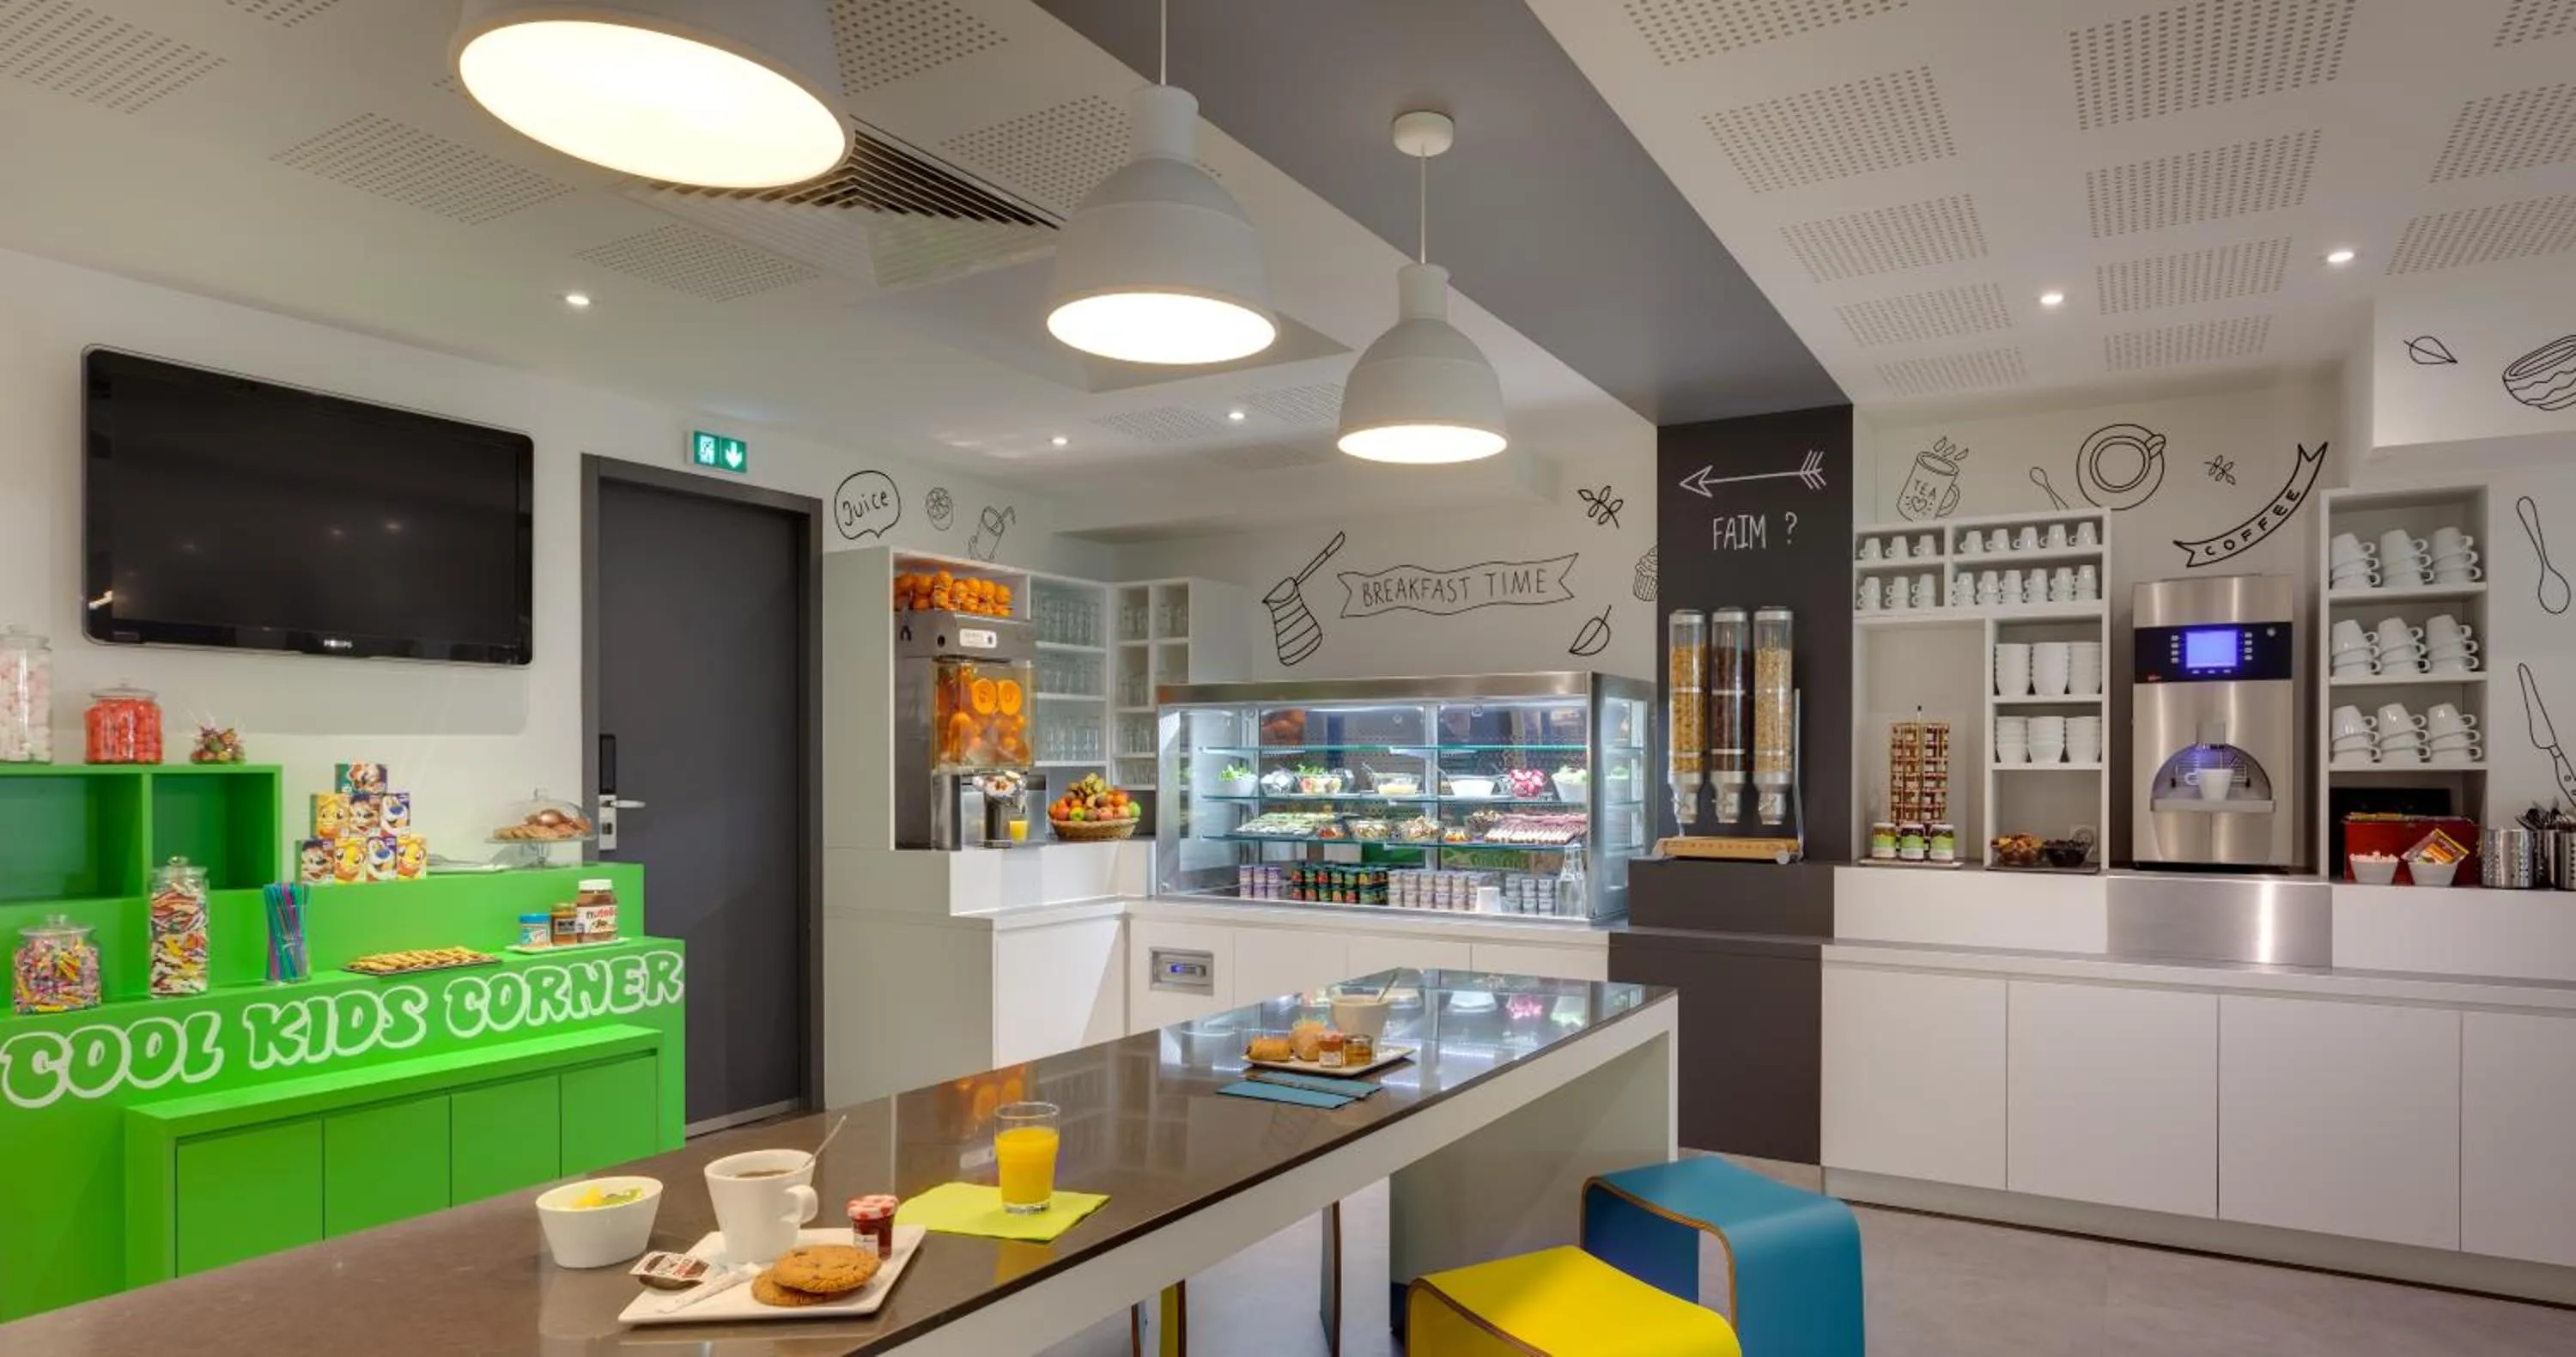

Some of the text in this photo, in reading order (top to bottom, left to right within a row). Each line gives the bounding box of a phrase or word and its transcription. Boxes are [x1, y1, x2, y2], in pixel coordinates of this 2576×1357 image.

[1915, 478, 1936, 500] TEA
[1713, 511, 1798, 551] FAIM ?
[2204, 489, 2300, 556] COFFEE
[1362, 569, 1547, 607] BREAKFAST TIME
[0, 950, 684, 1108] COOL KIDS CORNER
